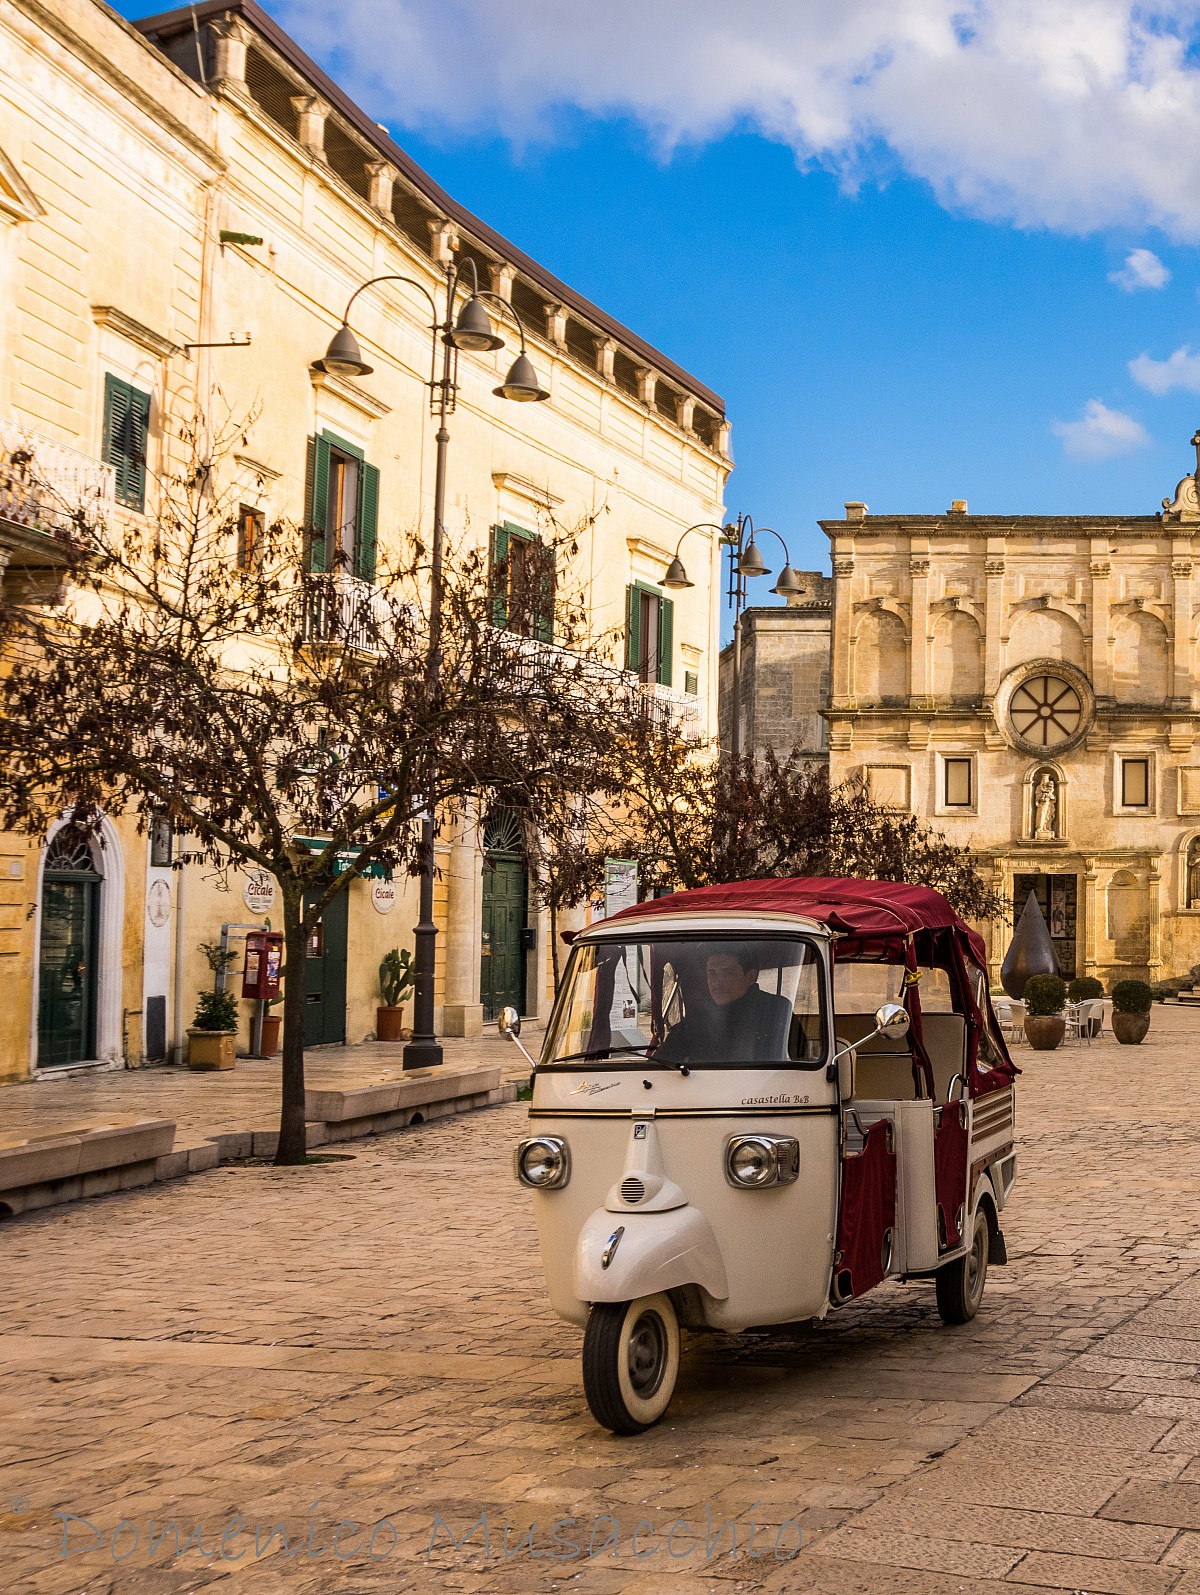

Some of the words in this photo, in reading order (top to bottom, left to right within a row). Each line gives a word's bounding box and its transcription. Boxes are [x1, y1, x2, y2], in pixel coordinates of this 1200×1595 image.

[247, 883, 273, 896] Cicale
[375, 887, 395, 899] Cicale
[741, 1094, 791, 1106] casastella
